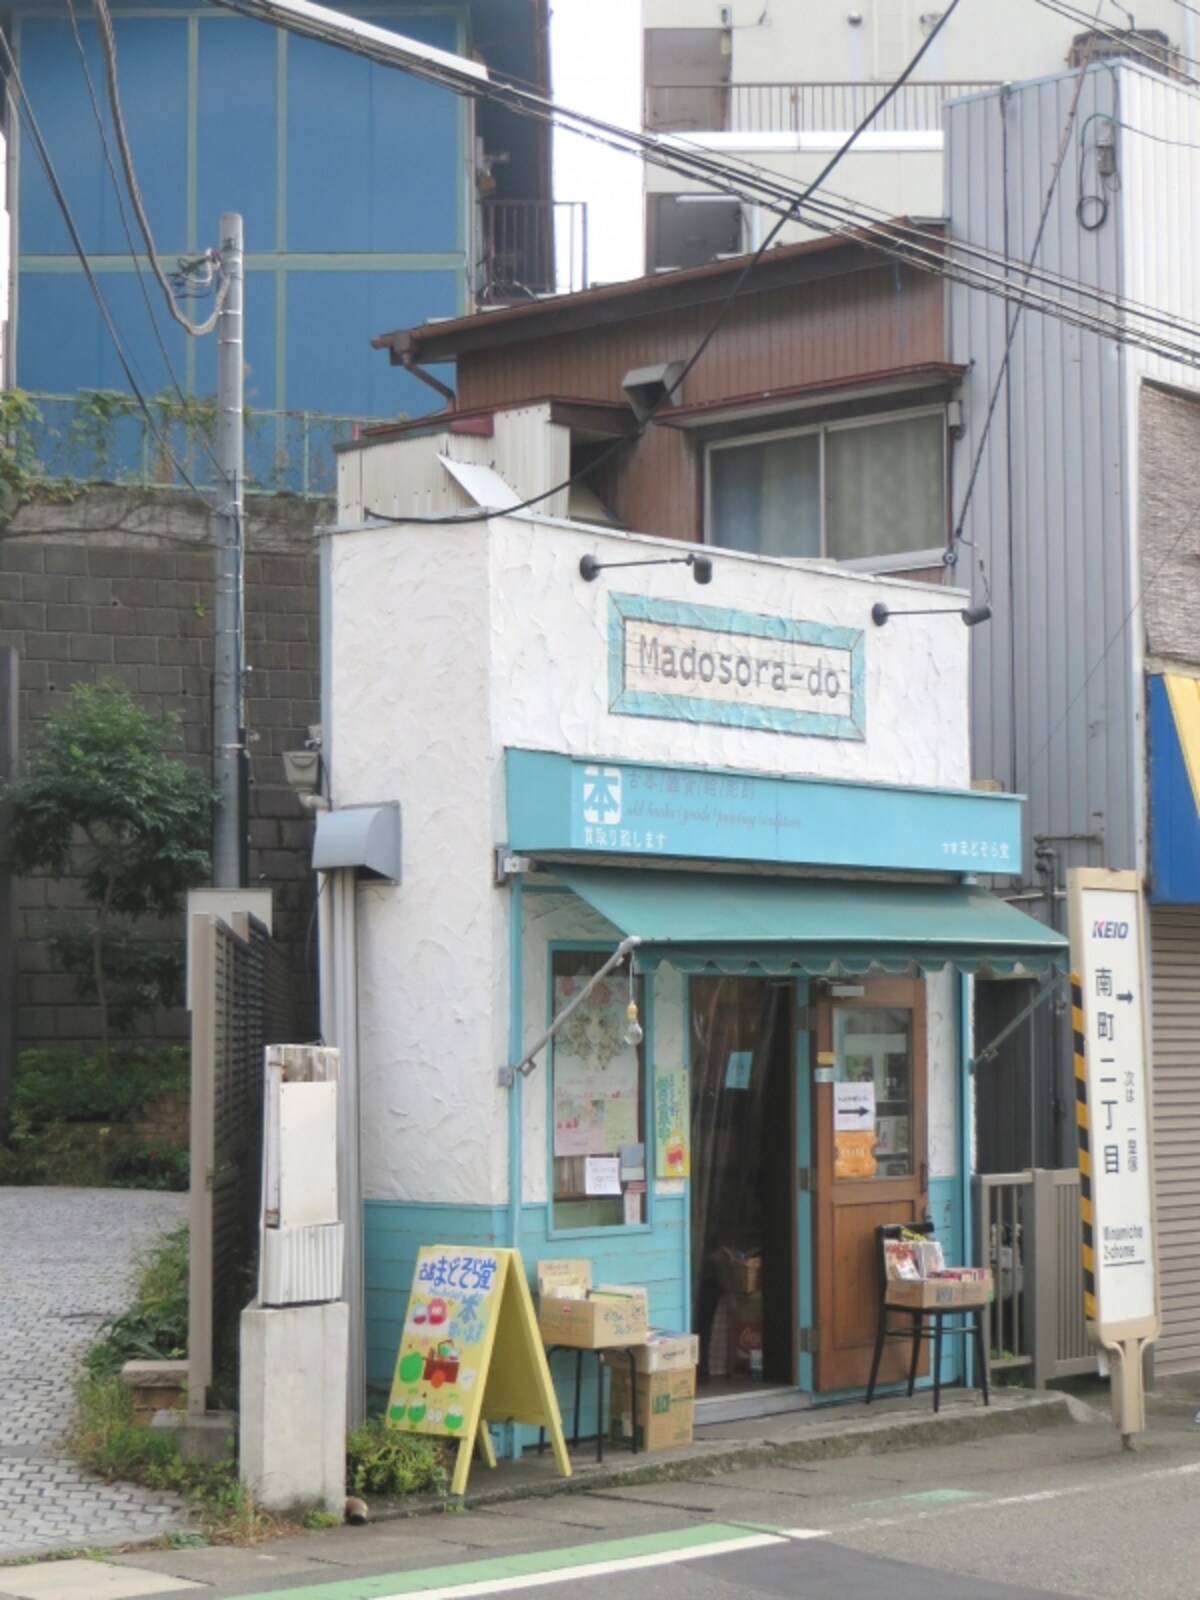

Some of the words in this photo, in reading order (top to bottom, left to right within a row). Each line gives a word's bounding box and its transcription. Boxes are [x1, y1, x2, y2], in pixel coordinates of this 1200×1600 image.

[639, 633, 841, 699] Madosora-do
[583, 765, 623, 826] 本
[1092, 920, 1129, 939] KEIO
[1094, 966, 1120, 1174] 南町二丁目
